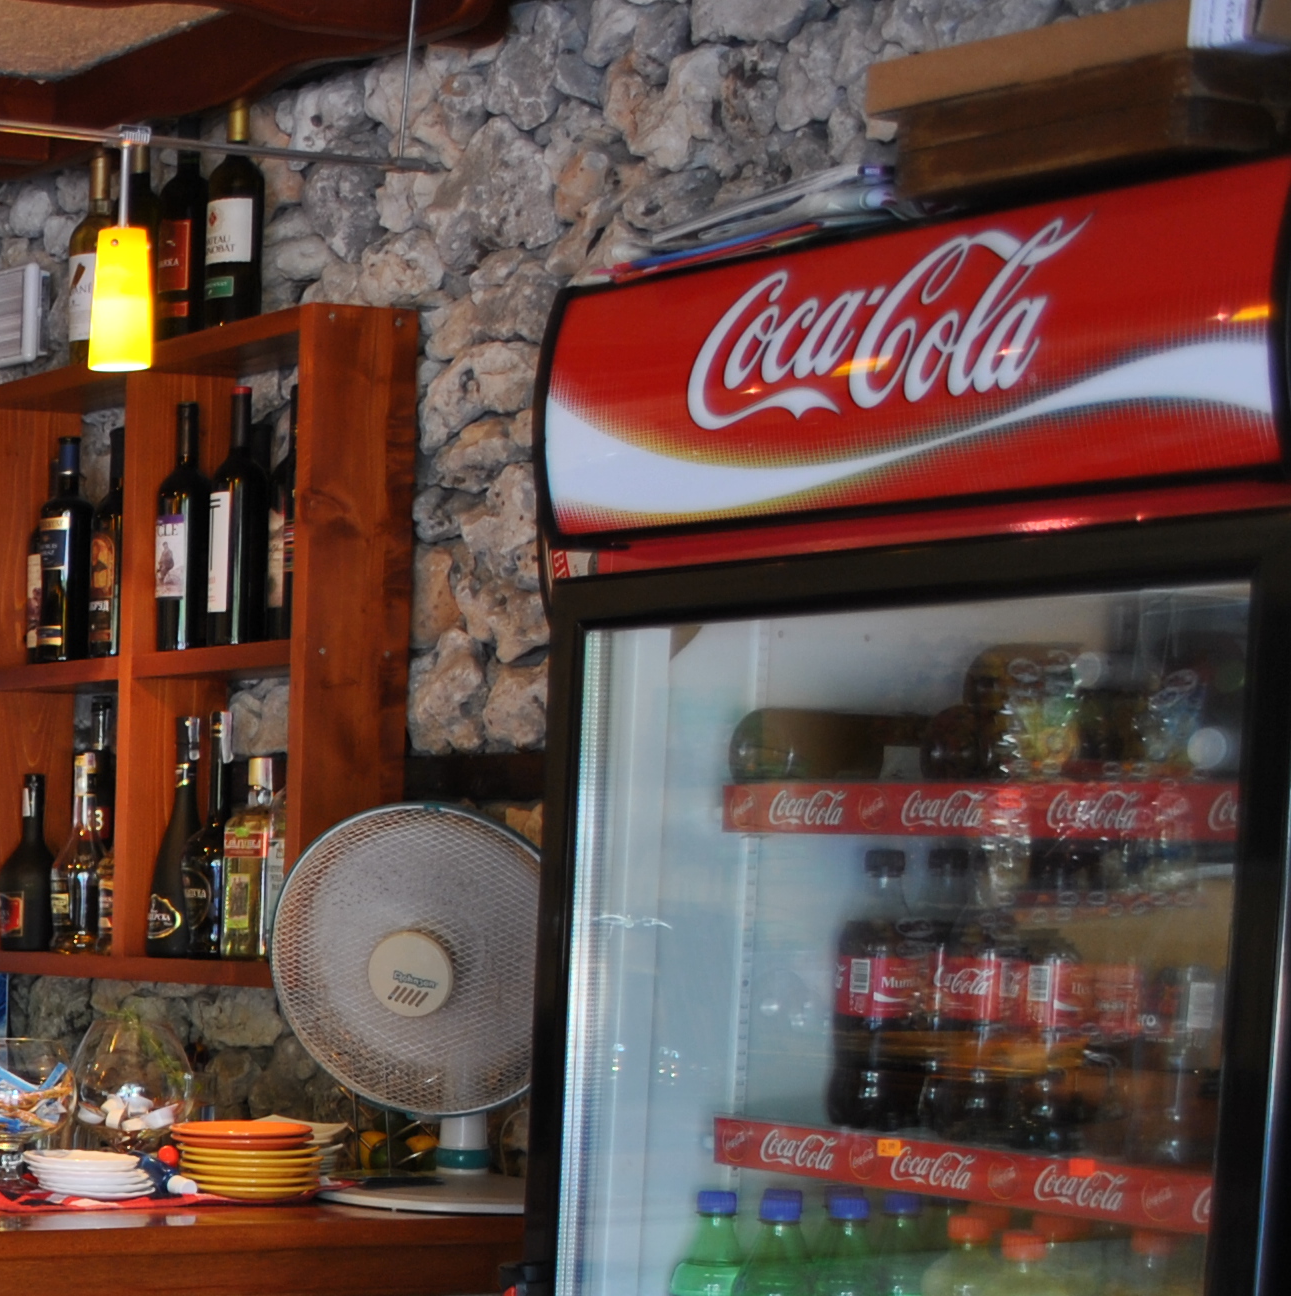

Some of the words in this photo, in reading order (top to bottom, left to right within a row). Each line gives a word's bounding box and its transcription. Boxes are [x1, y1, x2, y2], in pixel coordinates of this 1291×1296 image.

[688, 211, 1094, 431] Coca-Cola
[156, 523, 179, 538] CLE
[769, 790, 847, 826] Coca-Cola
[901, 789, 986, 828] Coca-Cola
[760, 1129, 838, 1172] Coca-Cola
[890, 1146, 975, 1191] Coca-Cola
[1033, 1164, 1129, 1212] Coca-Cola
